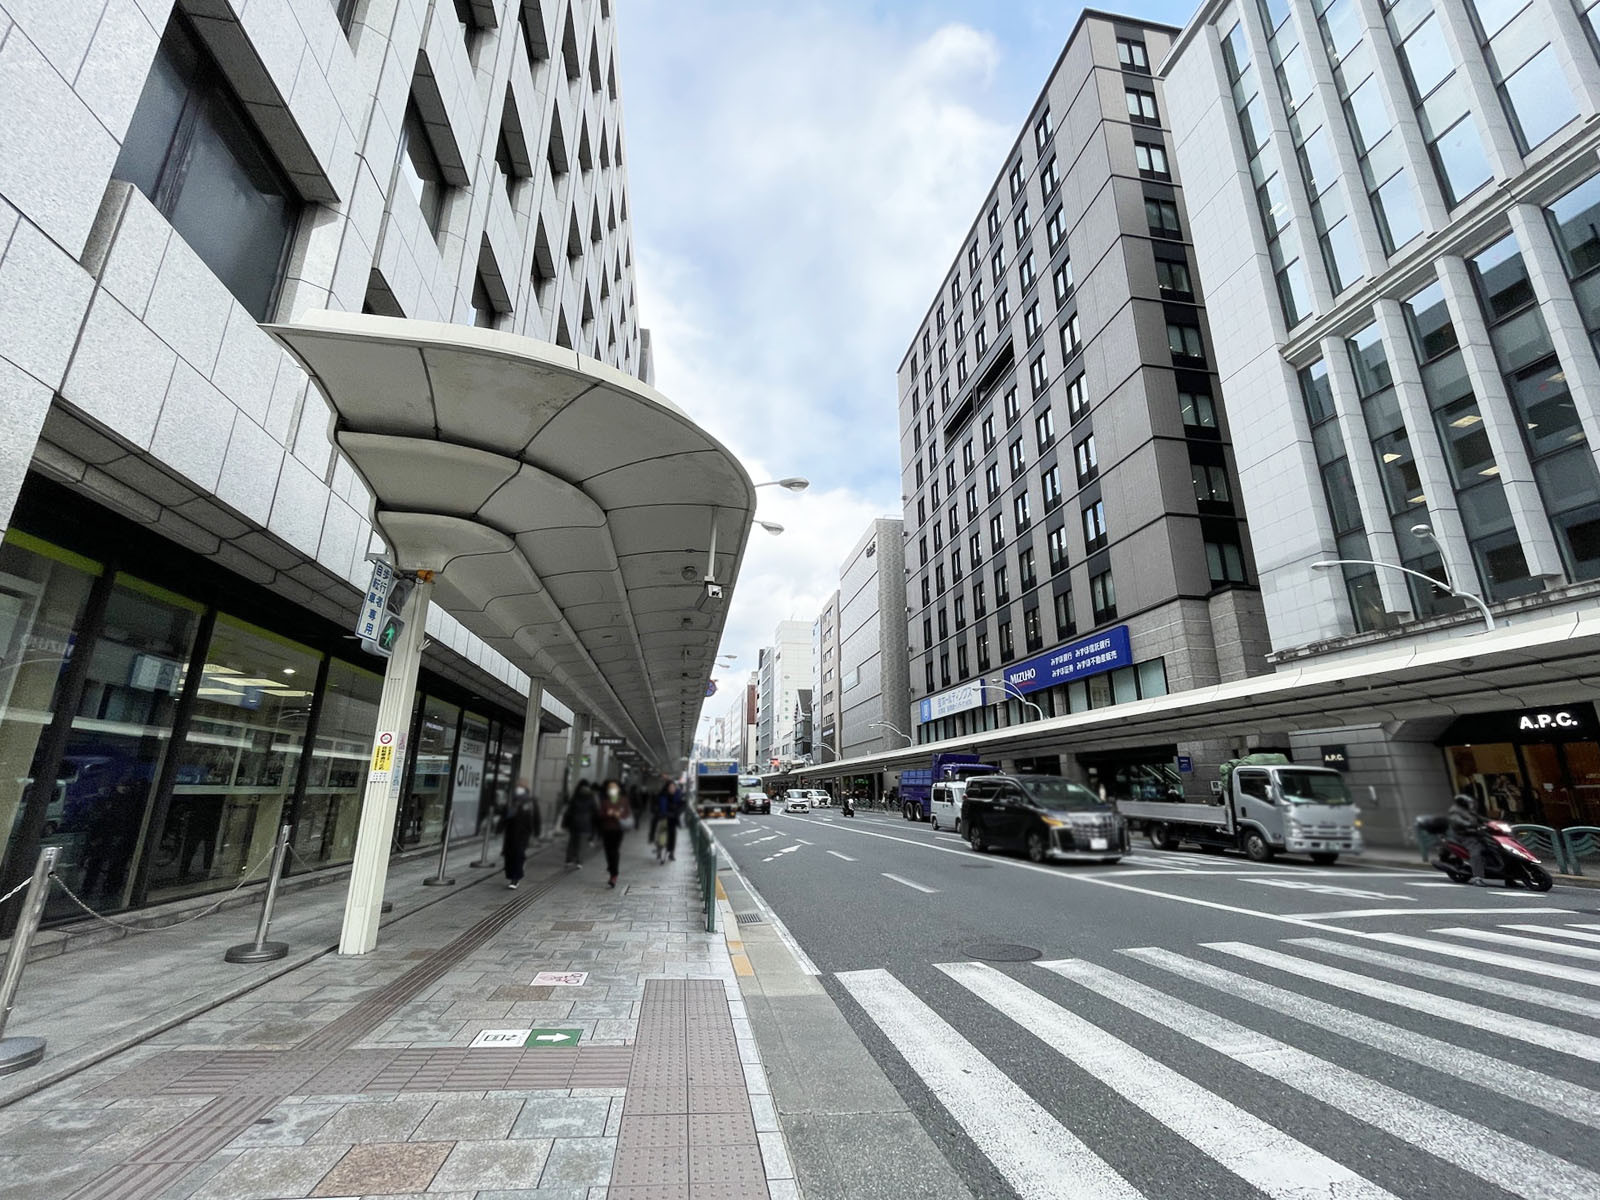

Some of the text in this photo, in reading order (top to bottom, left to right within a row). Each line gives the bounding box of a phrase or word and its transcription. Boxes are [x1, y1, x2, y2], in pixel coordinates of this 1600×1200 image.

[368, 564, 383, 604] 自転車
[376, 568, 391, 608] 歩行者
[364, 608, 377, 636] 専用
[1050, 638, 1111, 666] みずほ銀行 みずほ信託銀行
[1051, 650, 1118, 678] みずほ証券 みずほ不動産販売
[1009, 667, 1036, 684] MIZUHO
[1519, 711, 1578, 730] A.P.C.
[1324, 753, 1345, 762] A.P.C.
[456, 763, 481, 788] Olive
